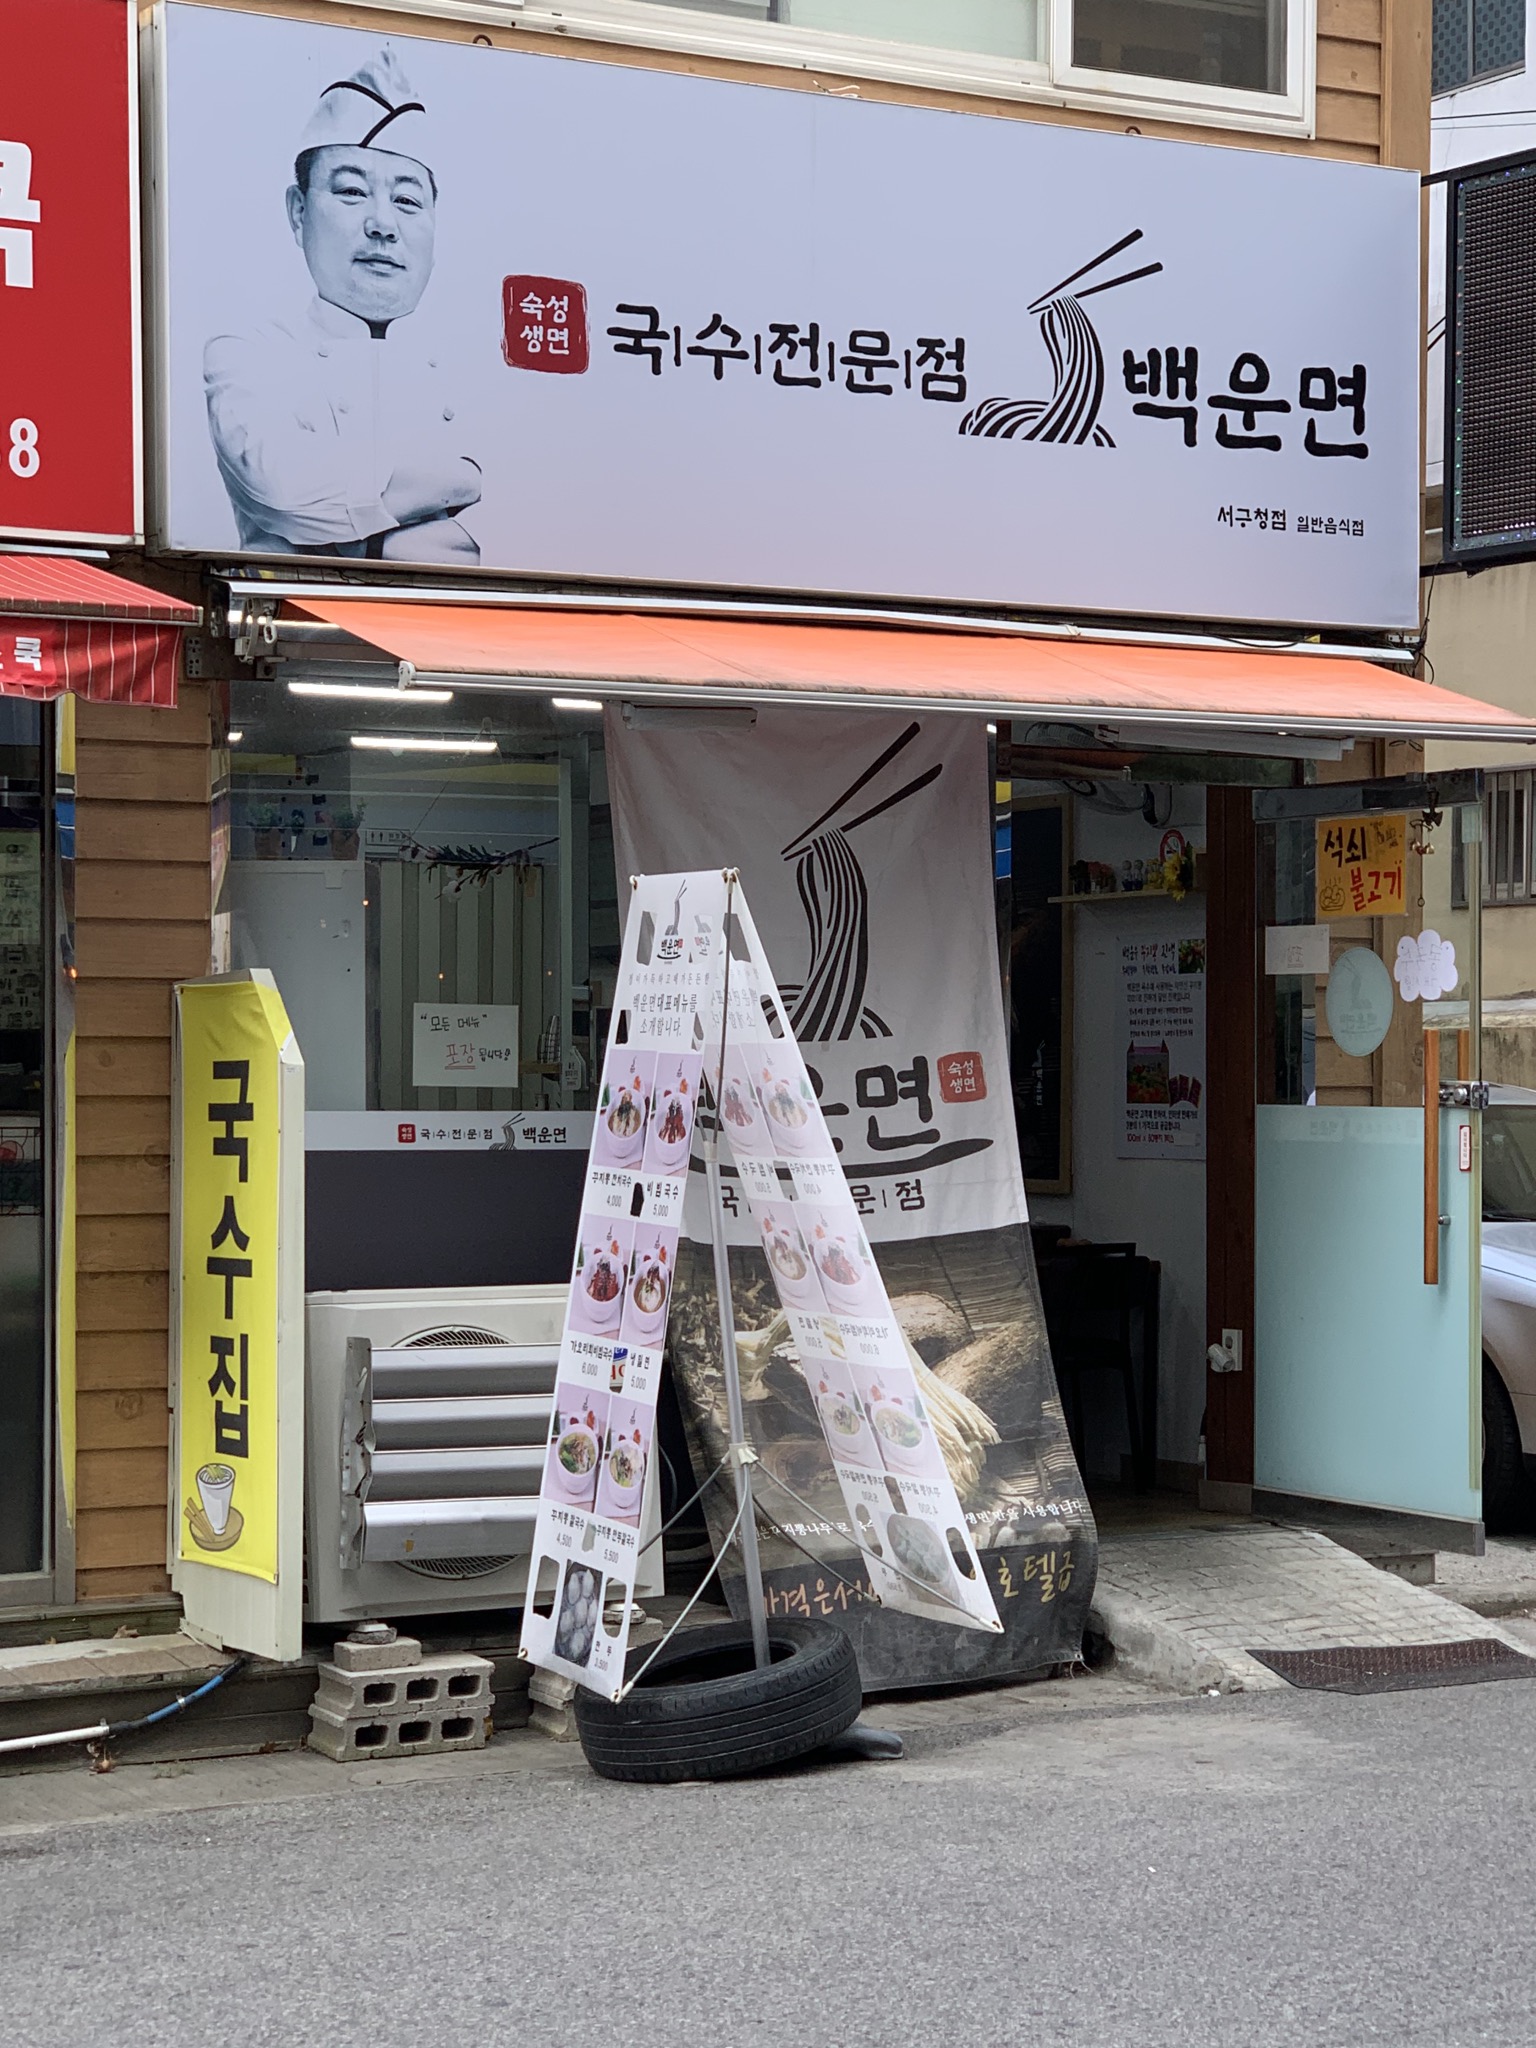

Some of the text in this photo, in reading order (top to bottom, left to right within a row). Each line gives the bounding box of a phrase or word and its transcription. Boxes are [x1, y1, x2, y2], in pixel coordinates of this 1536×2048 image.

[519, 291, 569, 324] 숙성
[520, 324, 570, 356] 생면
[1122, 346, 1369, 460] 백운면
[1217, 505, 1364, 537] 서구청점 일반음식점
[1323, 826, 1367, 868] 석쇠
[1349, 865, 1402, 912] 불고기
[446, 1043, 475, 1066] 포장
[948, 1060, 974, 1076] 숙성
[950, 1077, 977, 1093] 생면
[522, 1126, 567, 1144] 백운면
[607, 1194, 622, 1208] 4,000
[653, 1204, 669, 1217] 5,000
[206, 1059, 254, 1460] 국수집
